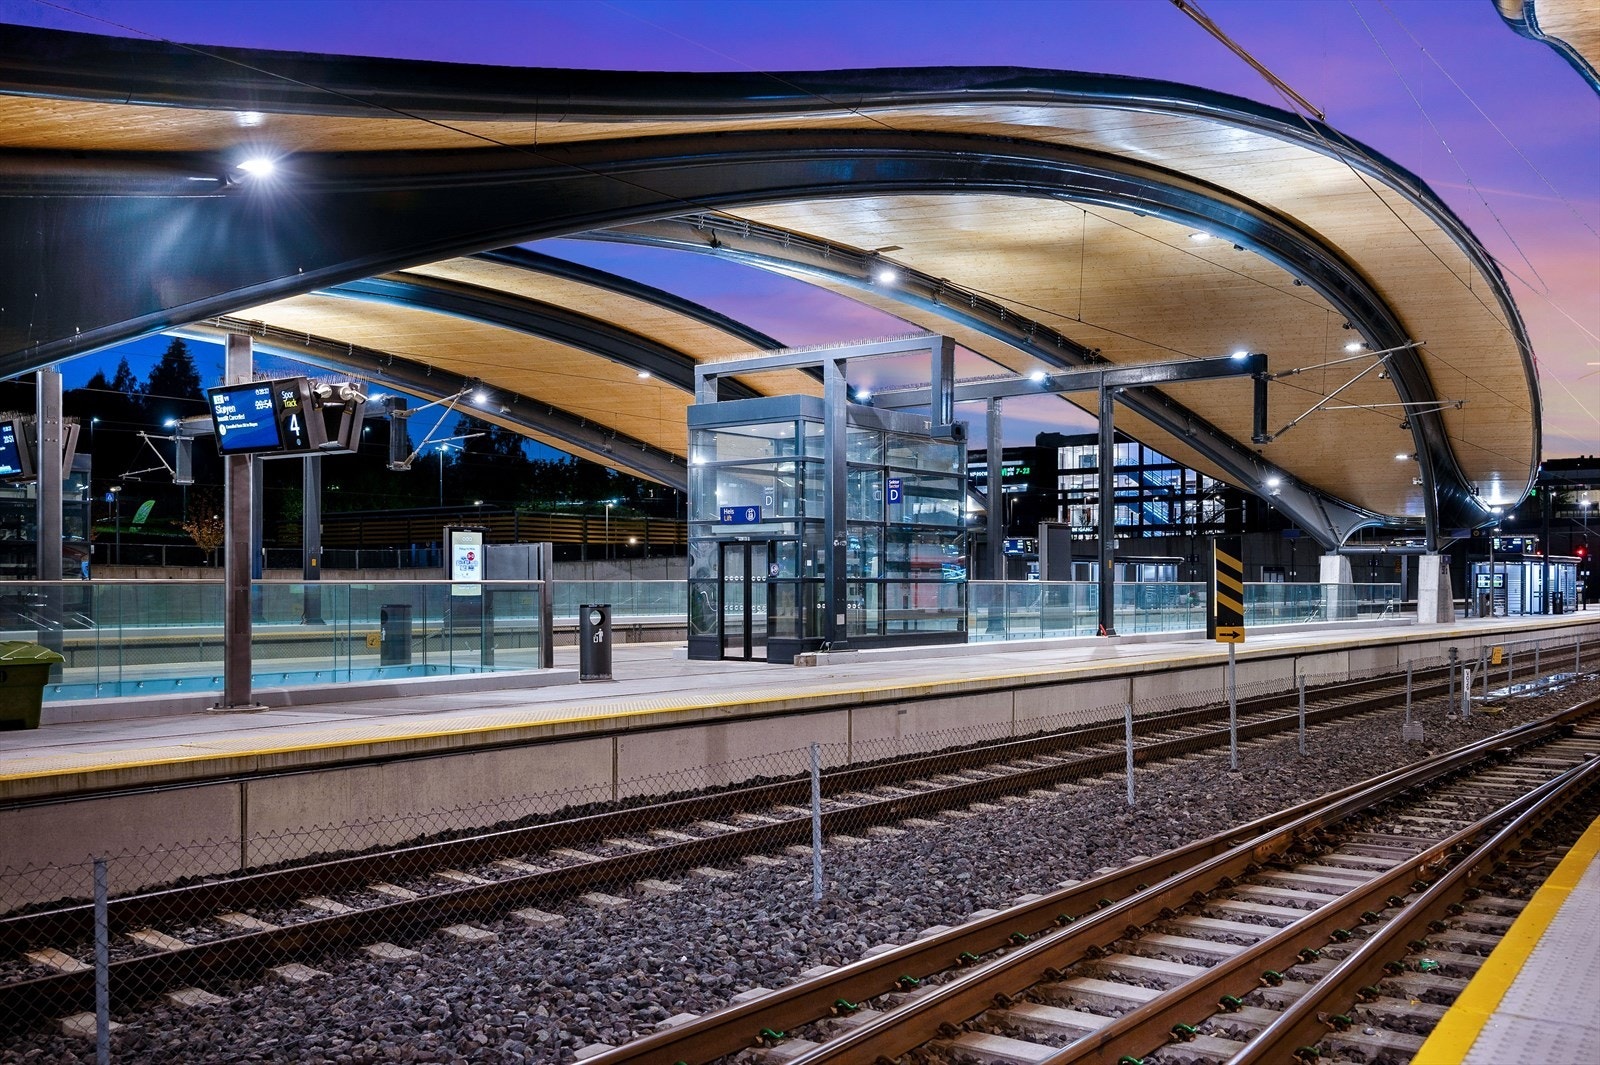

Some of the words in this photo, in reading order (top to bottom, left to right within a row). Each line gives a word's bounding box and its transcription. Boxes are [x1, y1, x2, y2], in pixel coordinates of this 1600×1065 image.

[281, 391, 293, 399] Spor
[284, 399, 297, 407] Track
[290, 413, 300, 436] 4
[890, 490, 898, 500] D
[766, 496, 772, 506] D
